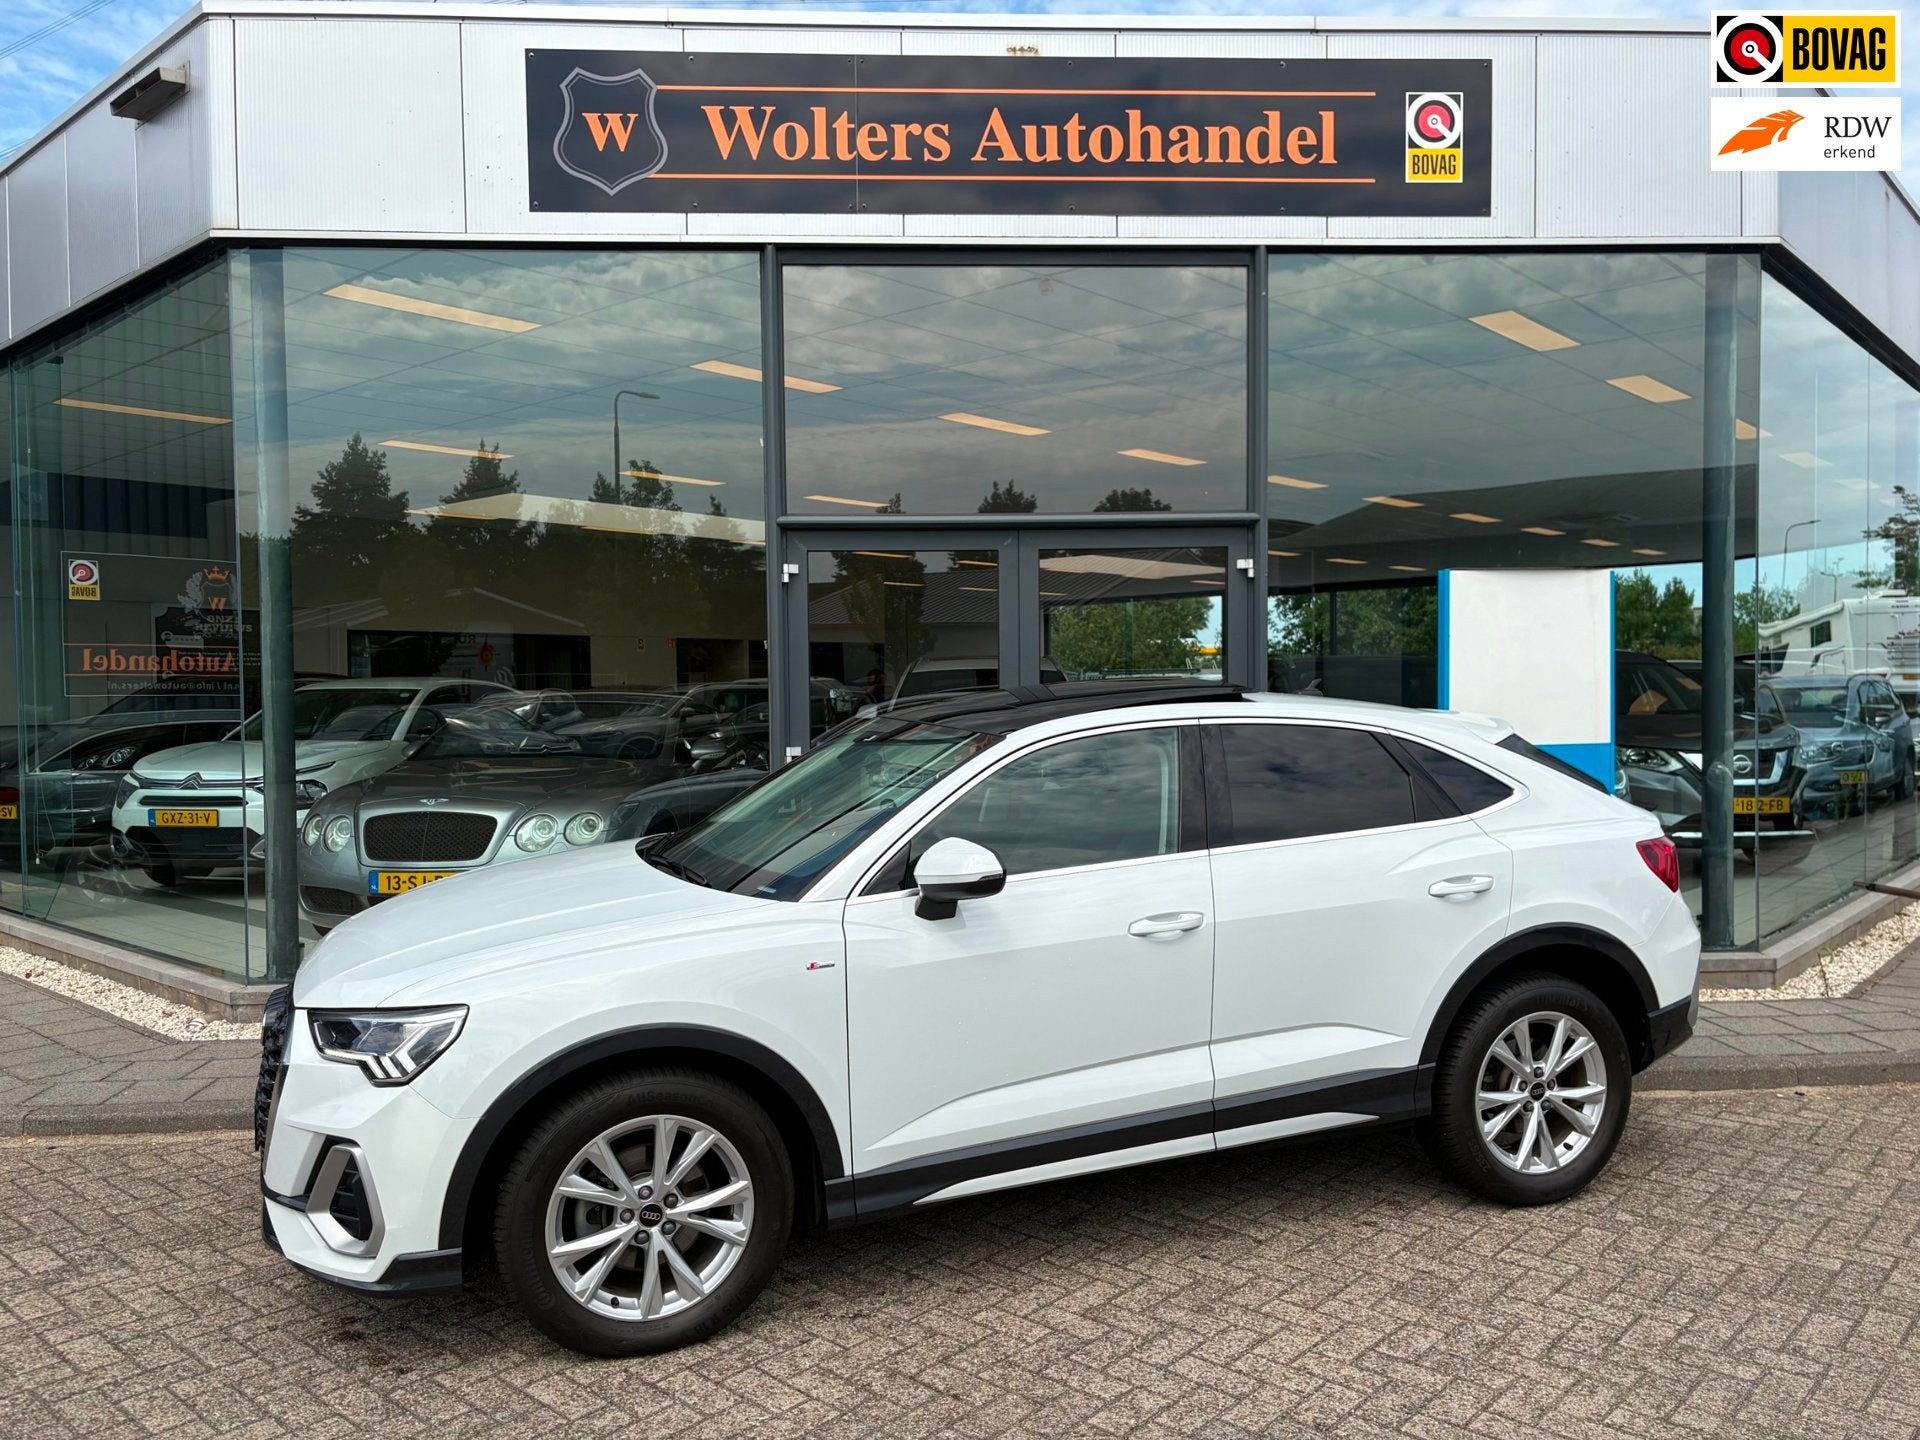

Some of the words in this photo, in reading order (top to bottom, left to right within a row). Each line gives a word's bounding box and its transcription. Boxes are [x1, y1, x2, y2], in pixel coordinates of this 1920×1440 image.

[582, 112, 639, 152] W
[701, 105, 952, 162] Wolters
[970, 107, 1338, 165] Autohandel
[1412, 154, 1456, 175] BOVAG
[161, 812, 211, 824] GXZ-31-V
